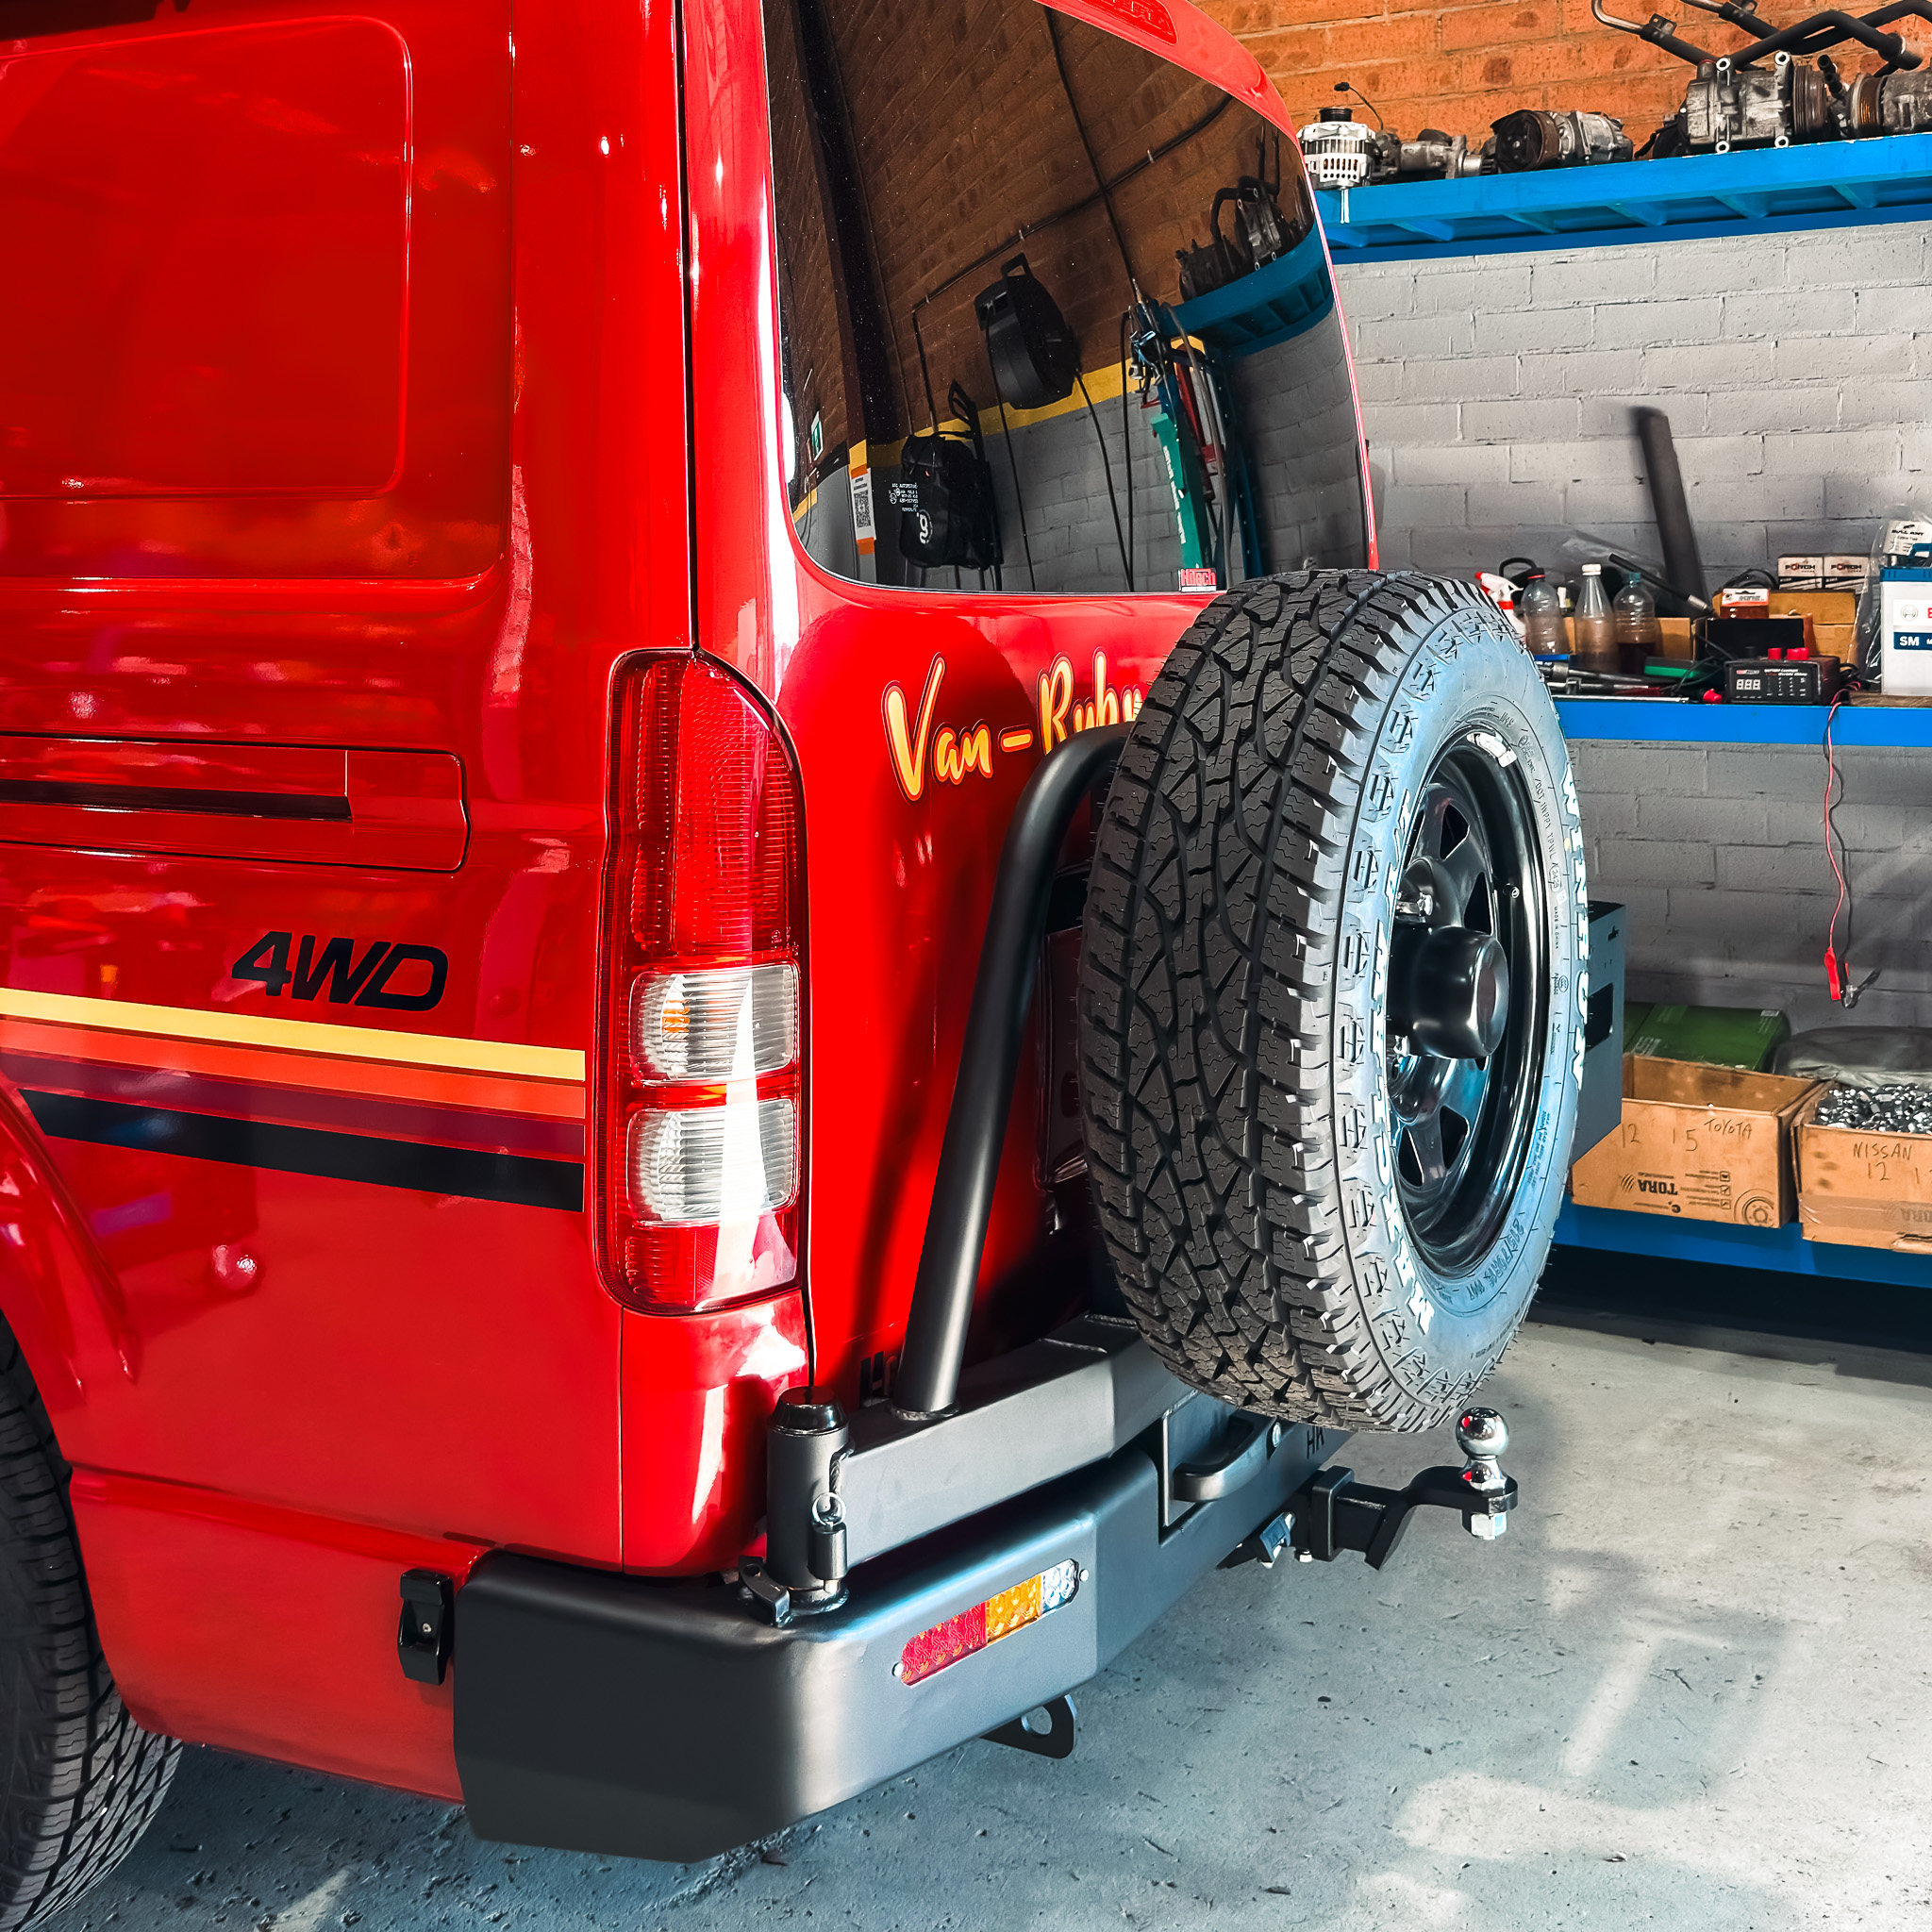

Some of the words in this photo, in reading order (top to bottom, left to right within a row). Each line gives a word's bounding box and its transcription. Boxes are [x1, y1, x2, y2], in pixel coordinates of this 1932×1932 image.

[1899, 635, 1920, 647] SM
[231, 930, 449, 1012] 4WD
[1622, 1123, 1641, 1148] 12
[1703, 1118, 1753, 1140] TOYOTA
[1853, 1141, 1912, 1160] NISSAN
[1868, 1161, 1892, 1182] 12
[1638, 1179, 1678, 1195] TORA
